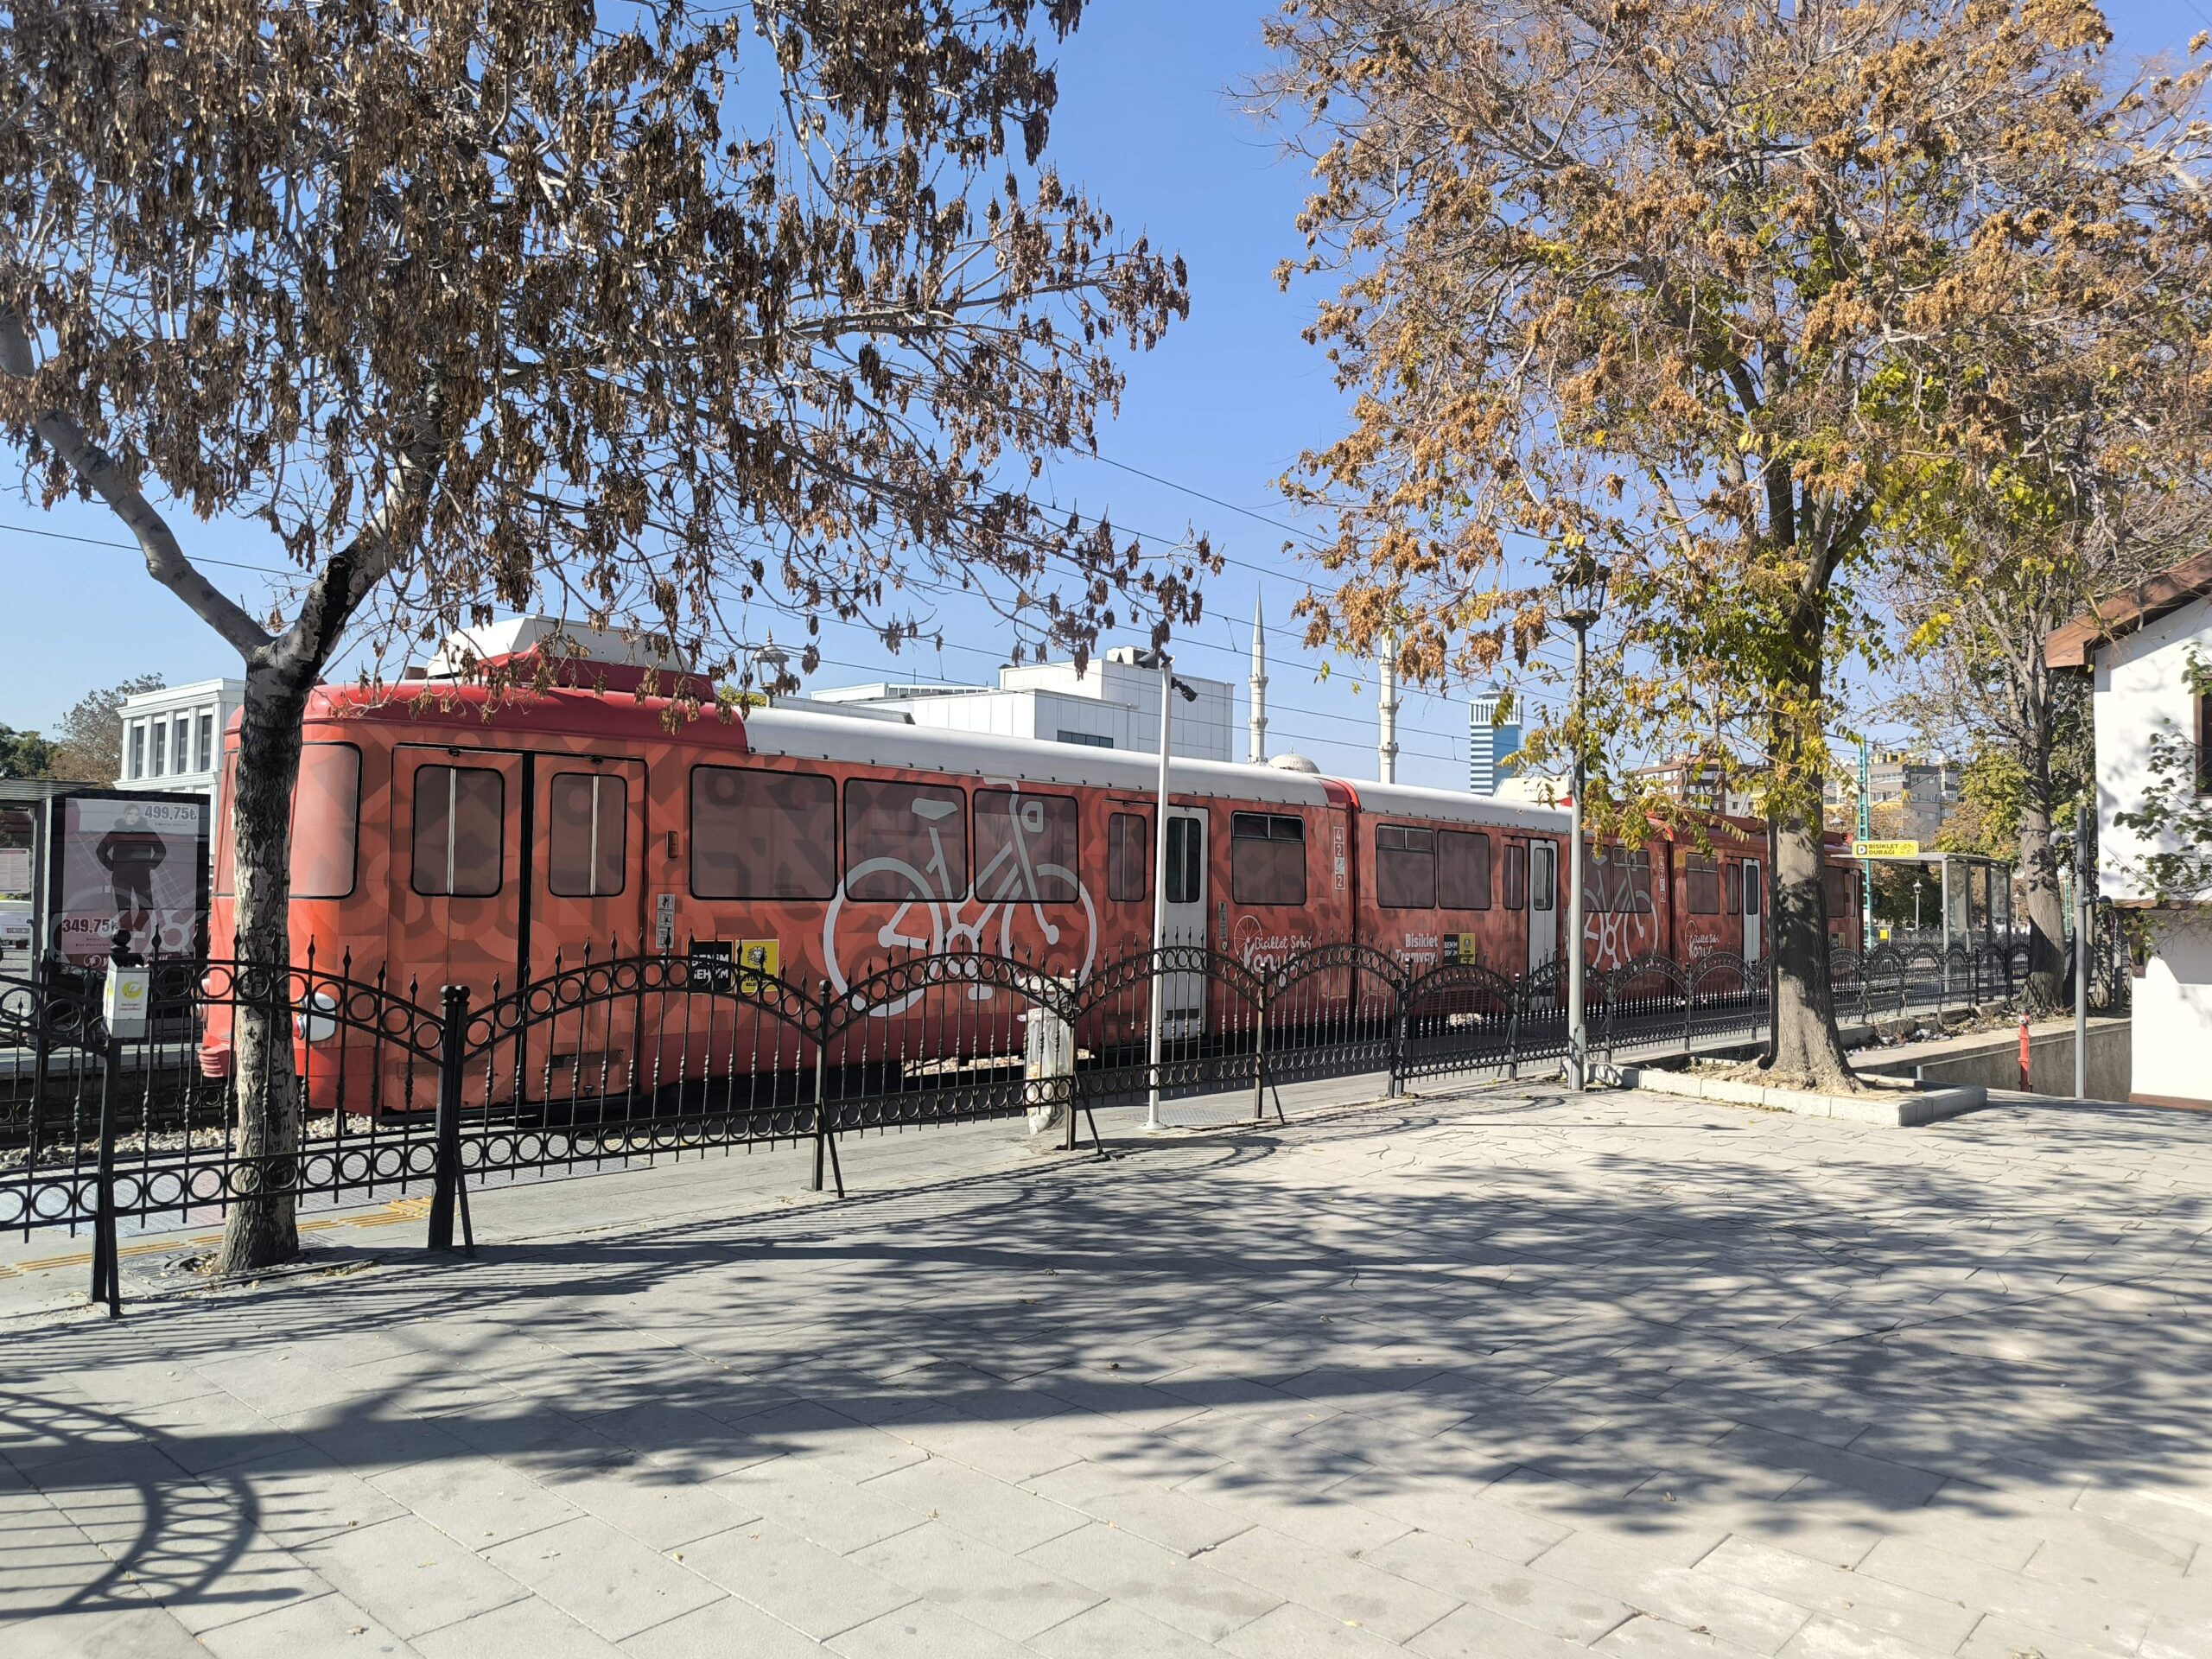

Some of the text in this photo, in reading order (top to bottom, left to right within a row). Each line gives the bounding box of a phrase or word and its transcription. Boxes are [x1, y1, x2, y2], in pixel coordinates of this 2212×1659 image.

[1857, 845, 1867, 855] D
[1255, 936, 1288, 950] Bisiklet
[1406, 933, 1439, 948] Bisiklet
